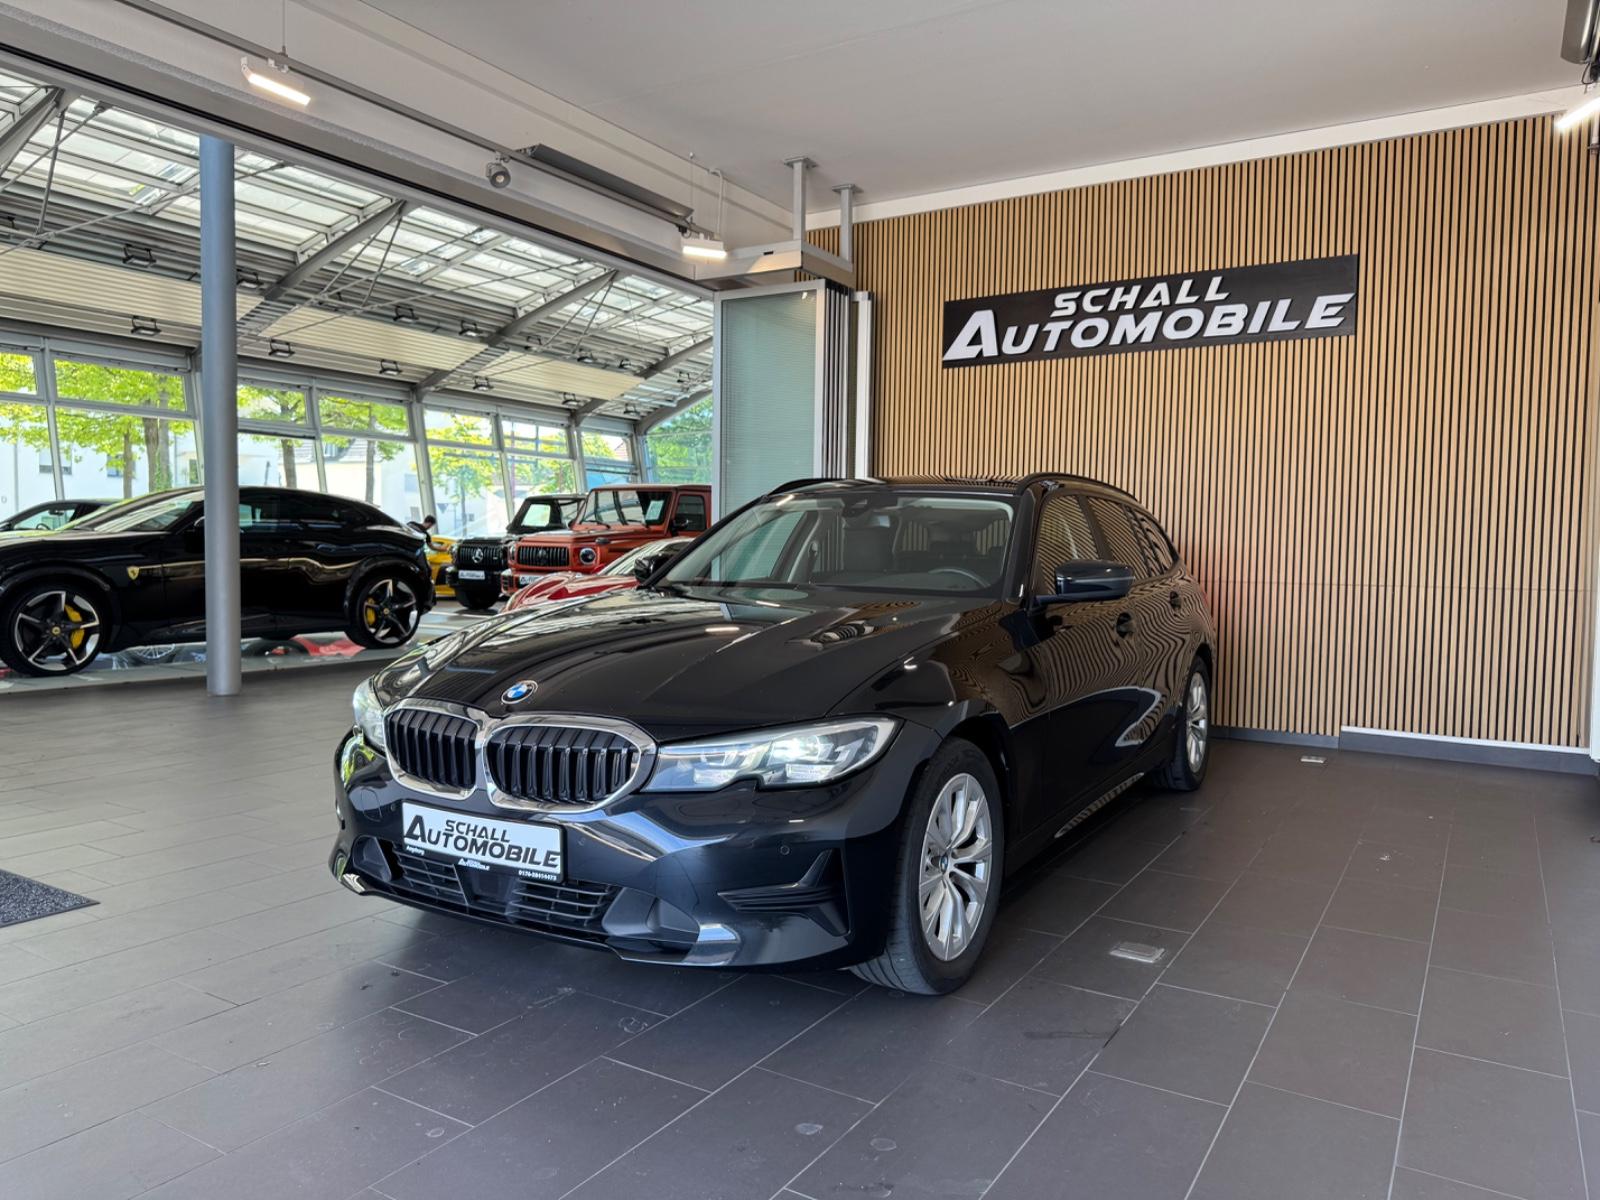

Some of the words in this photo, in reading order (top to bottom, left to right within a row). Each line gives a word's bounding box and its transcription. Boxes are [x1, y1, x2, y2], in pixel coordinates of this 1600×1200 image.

[1050, 275, 1231, 318] SCHALL
[942, 292, 1355, 361] AUTOMOBILE
[404, 815, 561, 868] AUTOMOBILE
[445, 819, 510, 843] SCHALL
